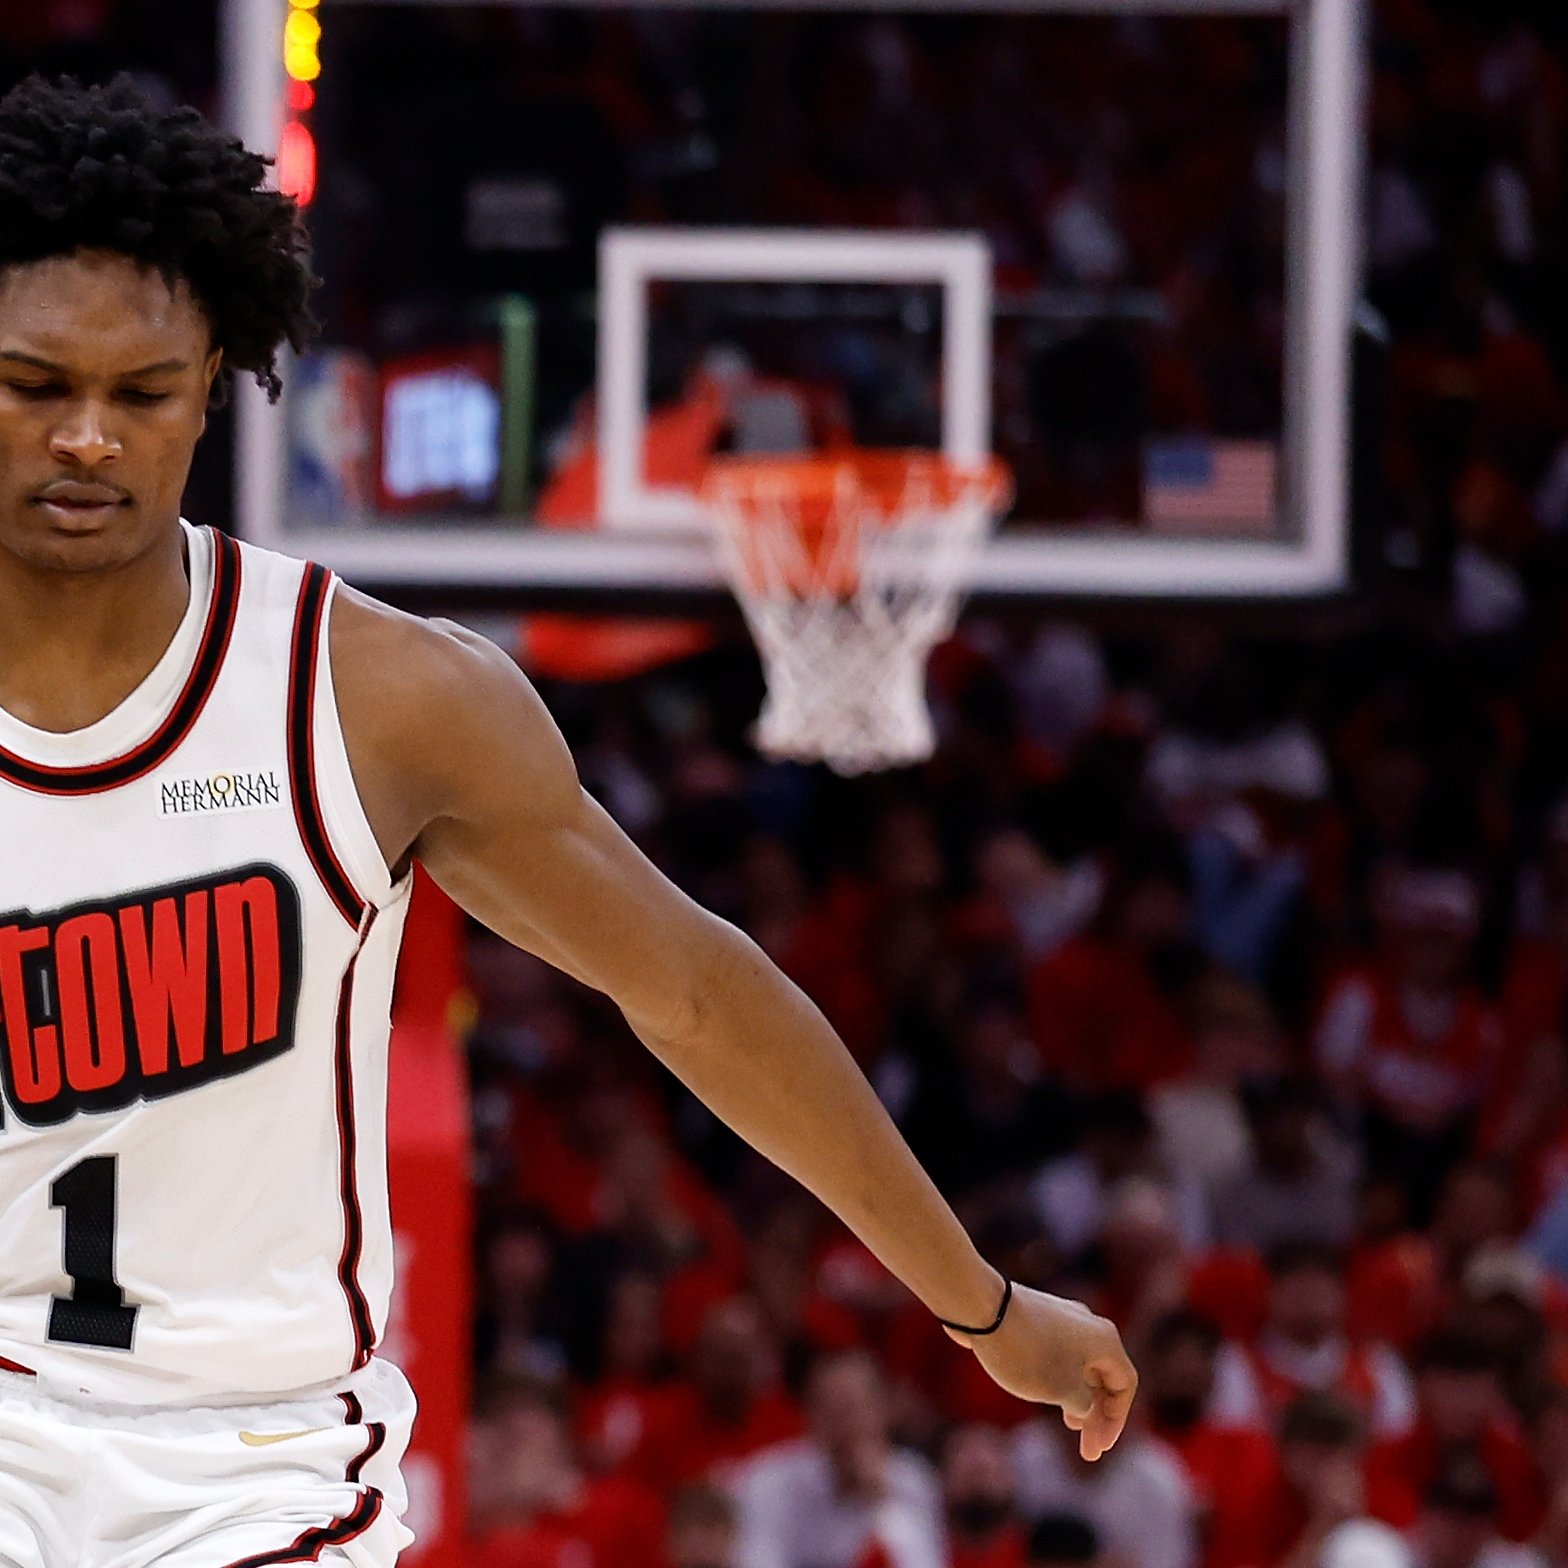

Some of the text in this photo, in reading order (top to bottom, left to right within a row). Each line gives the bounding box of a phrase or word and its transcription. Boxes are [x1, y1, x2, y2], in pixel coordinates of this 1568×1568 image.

[161, 771, 280, 800] MEMORIAL
[162, 788, 279, 814] HERMANN
[45, 1153, 140, 1351] 1
